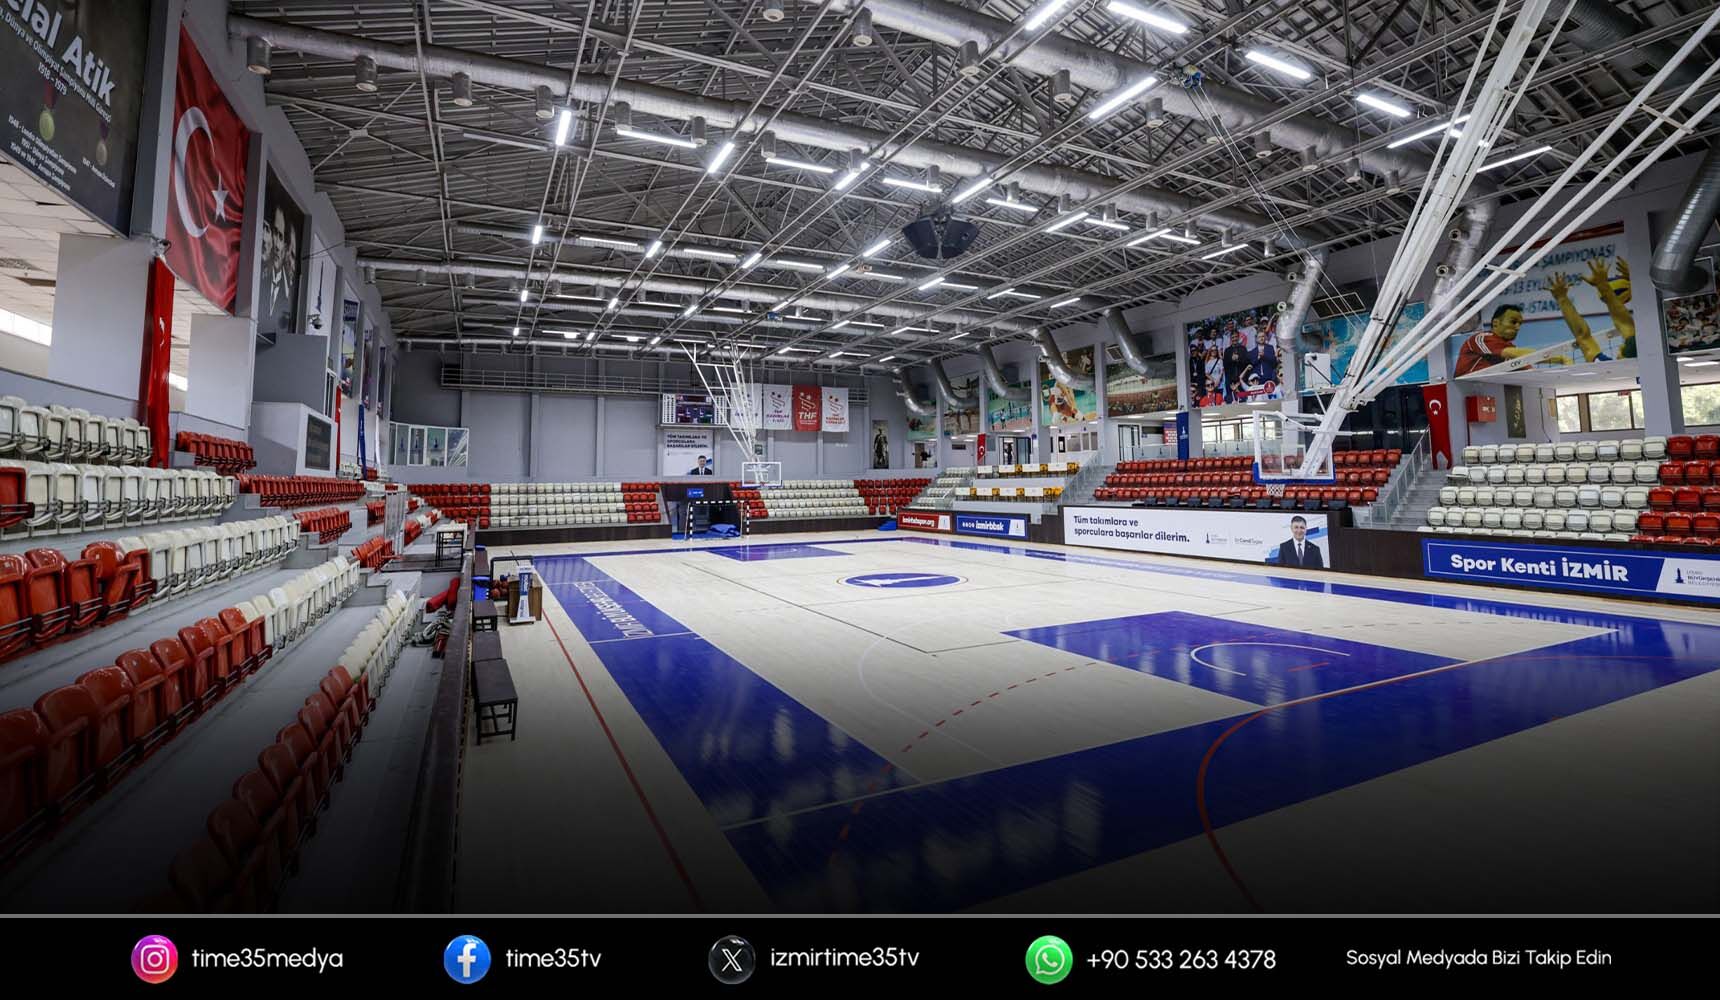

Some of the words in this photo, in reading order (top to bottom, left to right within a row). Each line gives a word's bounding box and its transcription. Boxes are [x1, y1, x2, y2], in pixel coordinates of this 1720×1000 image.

[4, 12, 25, 38] Dünya
[25, 36, 34, 46] ve
[33, 40, 60, 73] Olimpiyat
[38, 62, 51, 80] 1918
[54, 78, 67, 96] 1979
[61, 35, 116, 107] Atik
[799, 412, 817, 420] THF
[1074, 516, 1088, 524] Tüm
[1090, 516, 1127, 526] takımlara
[1074, 528, 1114, 536] sporculara
[1116, 529, 1153, 540] başarılar
[1155, 531, 1190, 542] dilerim.
[1450, 554, 1496, 574] Spor
[1501, 557, 1556, 576] Kenti
[1562, 557, 1629, 582] İZMİR
